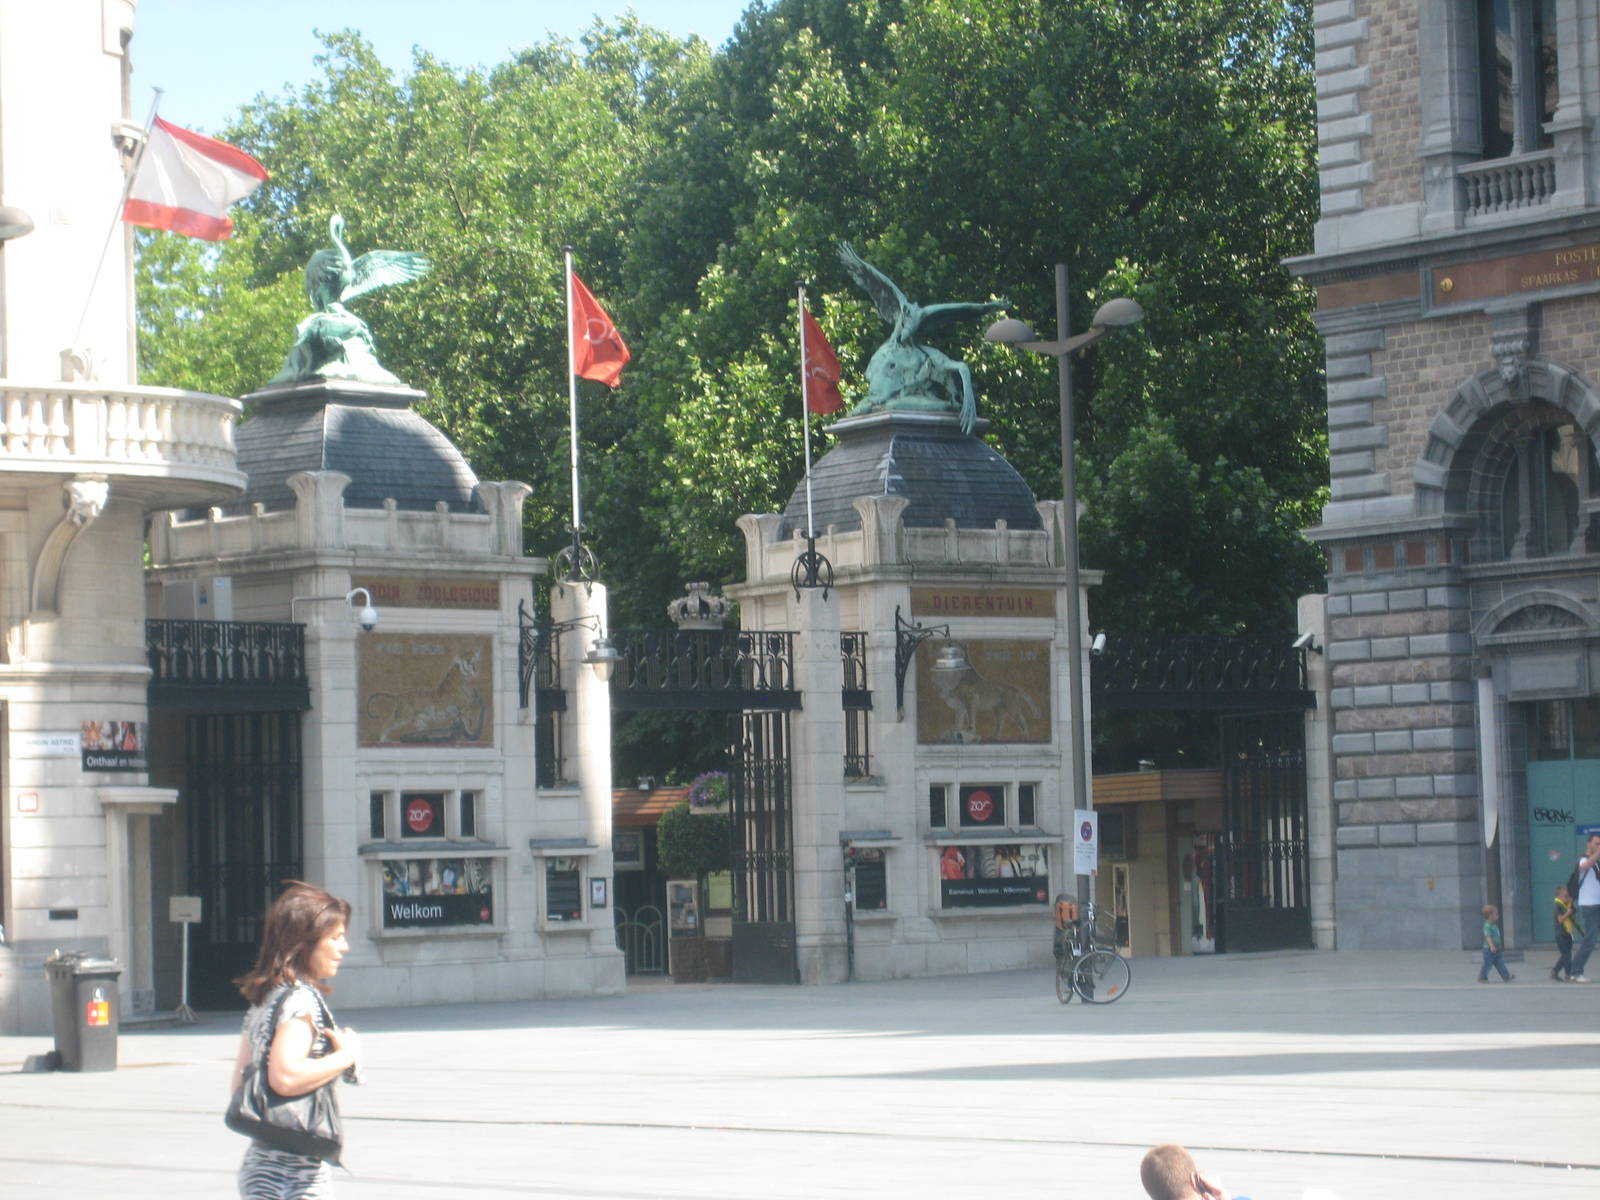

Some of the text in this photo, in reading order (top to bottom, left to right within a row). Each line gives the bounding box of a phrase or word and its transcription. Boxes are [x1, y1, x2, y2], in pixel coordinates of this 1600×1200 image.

[932, 595, 1033, 610] DIERENTUIN
[86, 756, 118, 768] Onthaal
[390, 903, 442, 920] Welkom
